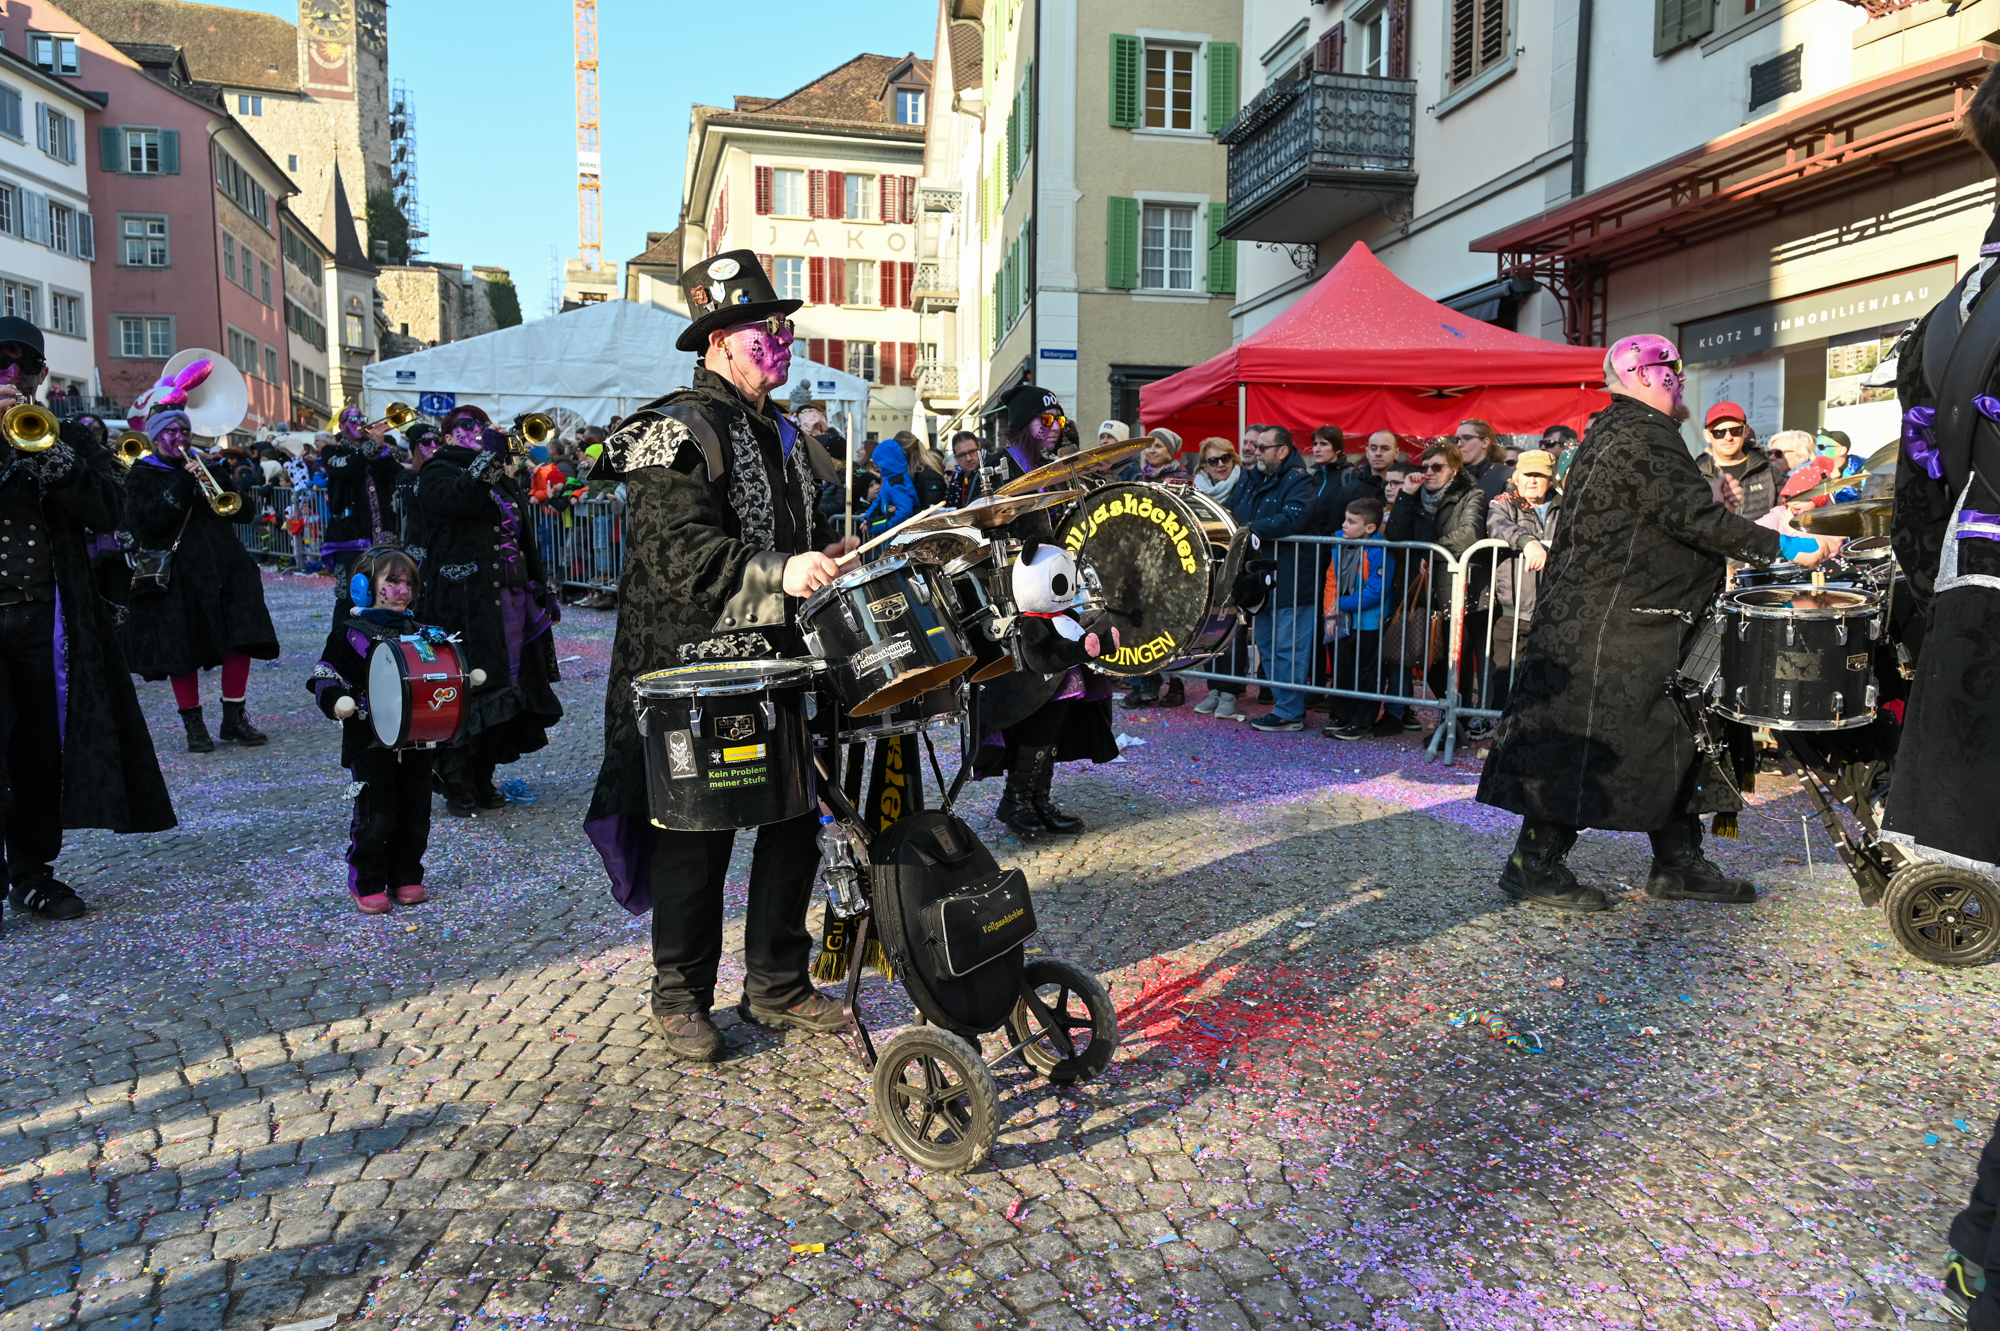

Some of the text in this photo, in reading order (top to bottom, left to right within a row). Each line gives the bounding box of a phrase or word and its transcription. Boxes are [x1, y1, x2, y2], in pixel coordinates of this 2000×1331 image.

[1699, 286, 1930, 349] KLOTZ IMMOBILIEN/BAU
[709, 766, 767, 779] Kein Problem
[709, 776, 766, 789] meiner Stufe
